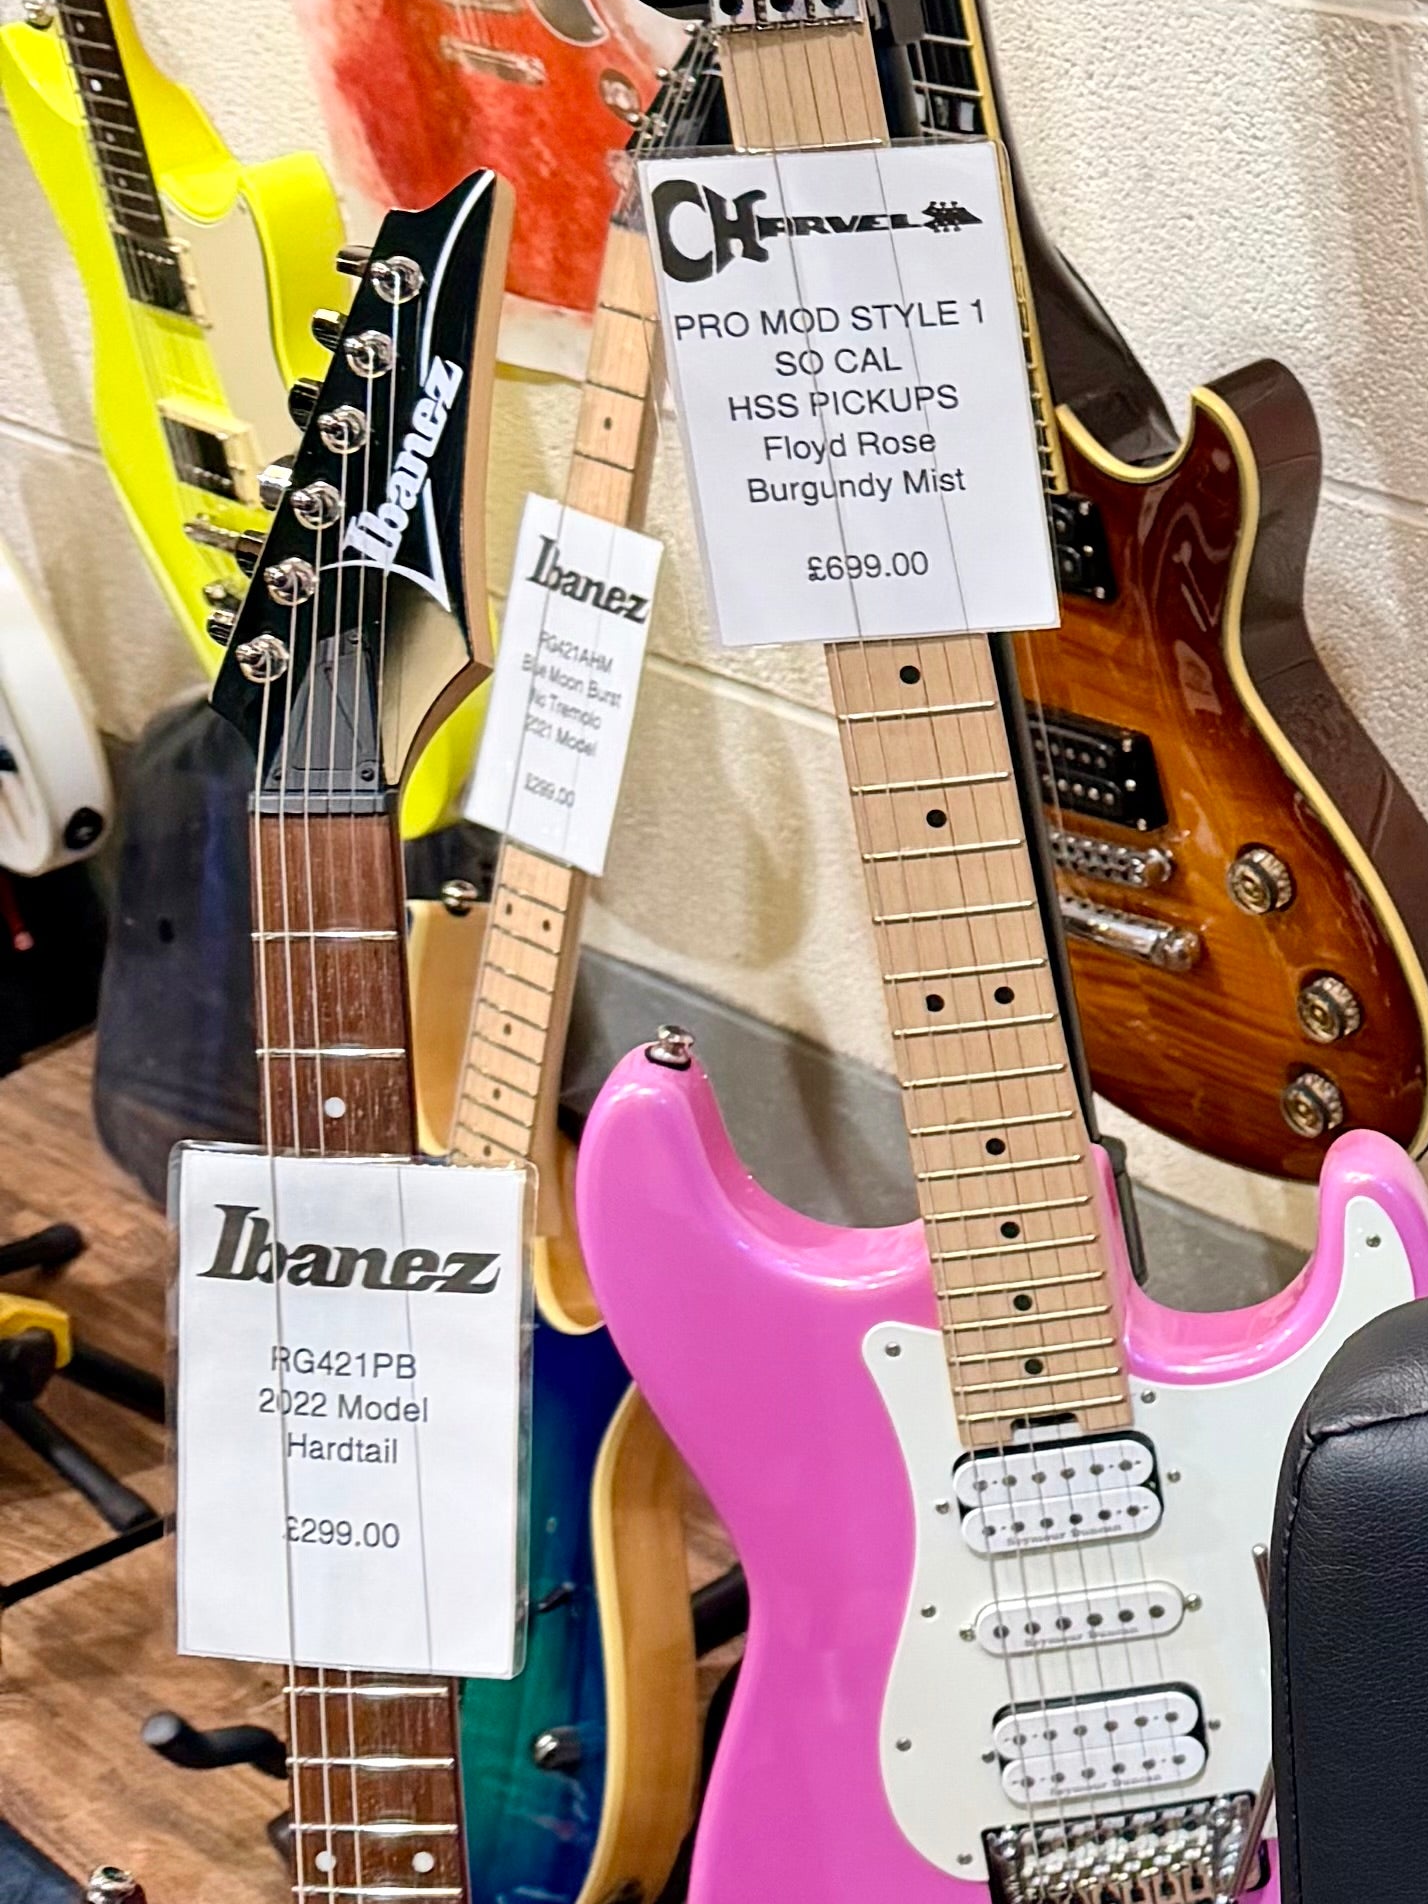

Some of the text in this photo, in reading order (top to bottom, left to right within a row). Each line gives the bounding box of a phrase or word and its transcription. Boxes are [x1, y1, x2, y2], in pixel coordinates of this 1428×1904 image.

[675, 298, 984, 340] PRO MOD STYLE 1
[776, 347, 902, 376] SO CAL
[729, 384, 959, 420] HSS PICKUPS
[341, 355, 464, 565] Ibanez
[764, 431, 936, 464] Floyd Rose
[748, 468, 966, 505] Burgundy Mist
[526, 534, 650, 624] Ibanez
[808, 551, 929, 581] £699.00
[550, 666, 583, 693] Moon
[588, 679, 622, 709] Burst
[556, 727, 597, 756] Model
[196, 1203, 501, 1294] Ibanez
[271, 1346, 417, 1380] RG421PB
[258, 1388, 429, 1423] 2022 Model
[286, 1432, 398, 1464] Hardtail
[285, 1516, 400, 1548] £299.00
